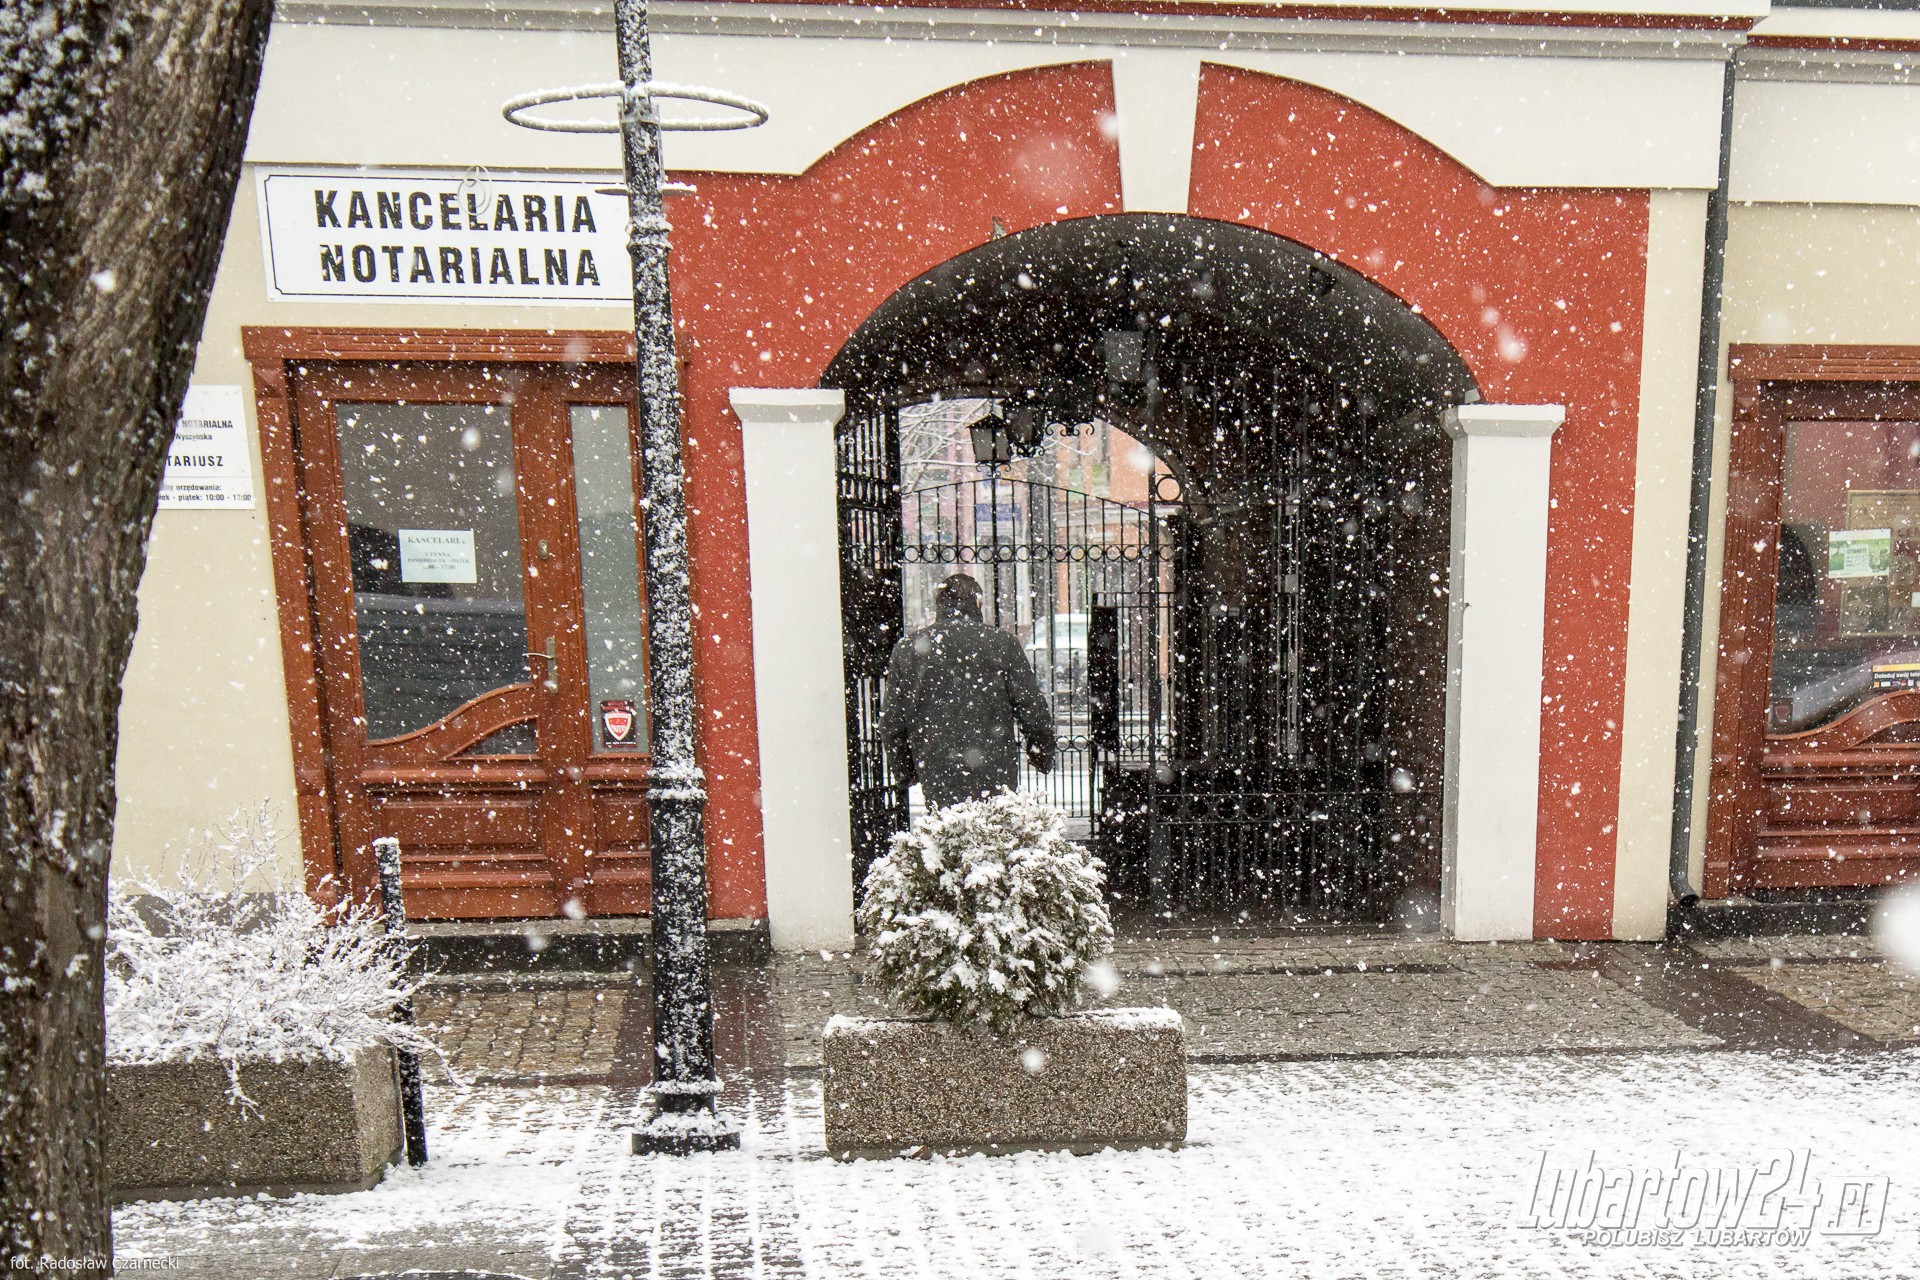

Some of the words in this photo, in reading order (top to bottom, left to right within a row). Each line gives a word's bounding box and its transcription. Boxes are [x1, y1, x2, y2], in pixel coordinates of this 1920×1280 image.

[314, 190, 597, 233] KANCELARIA
[319, 244, 601, 286] NOTARIALNA
[181, 420, 233, 428] NOTARIALNA
[178, 494, 203, 502] piątek:
